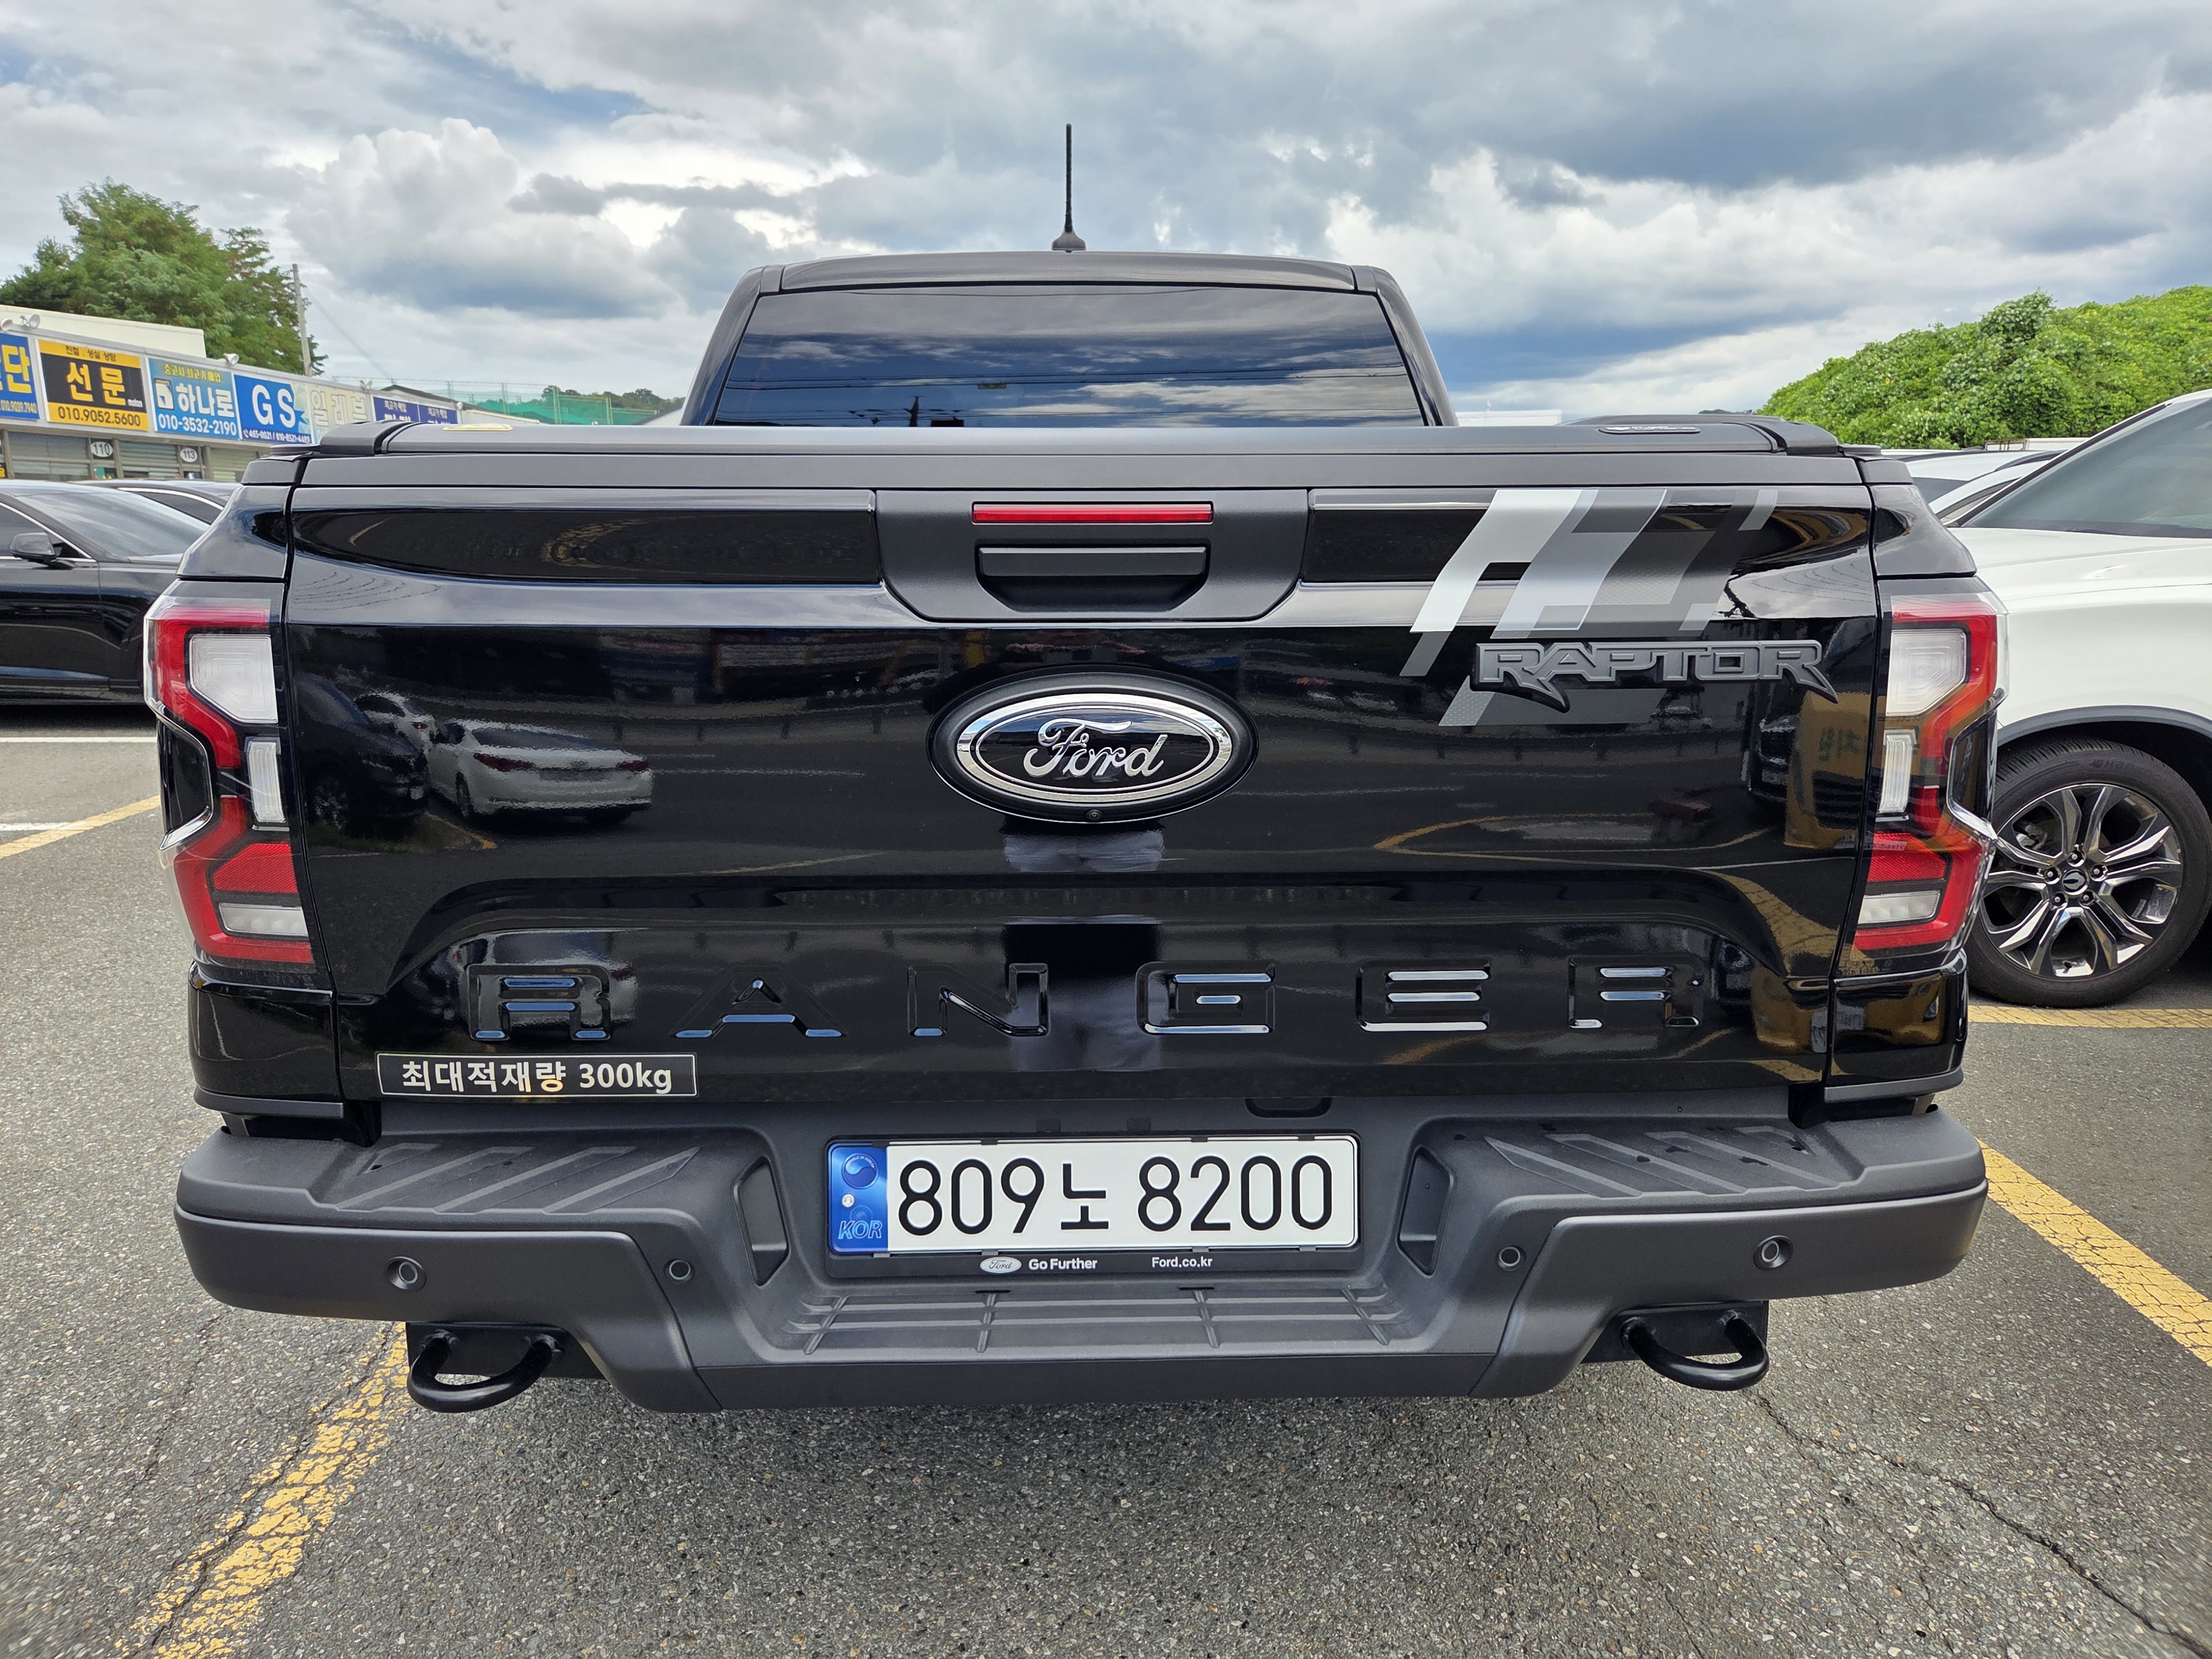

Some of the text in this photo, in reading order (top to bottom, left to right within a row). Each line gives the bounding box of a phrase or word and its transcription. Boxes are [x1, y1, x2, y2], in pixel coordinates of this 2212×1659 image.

[0, 345, 32, 393] 단
[176, 383, 235, 418] 하나로
[58, 406, 140, 427] 010.9052.5600
[158, 413, 237, 436] 010-3532-2190
[93, 444, 109, 456] 110
[183, 450, 196, 460] 113
[1477, 639, 1838, 713] RAPTOR
[1023, 717, 1168, 778] Ford
[468, 954, 1703, 1041] RANGER
[402, 1060, 672, 1094] 최대적재량 300kg
[898, 1155, 1334, 1237] 809노 8200
[838, 1219, 883, 1240] KOR
[988, 1259, 1013, 1270] Ford
[1029, 1258, 1098, 1270] Go Further
[1151, 1256, 1213, 1268] Ford.co.kr
